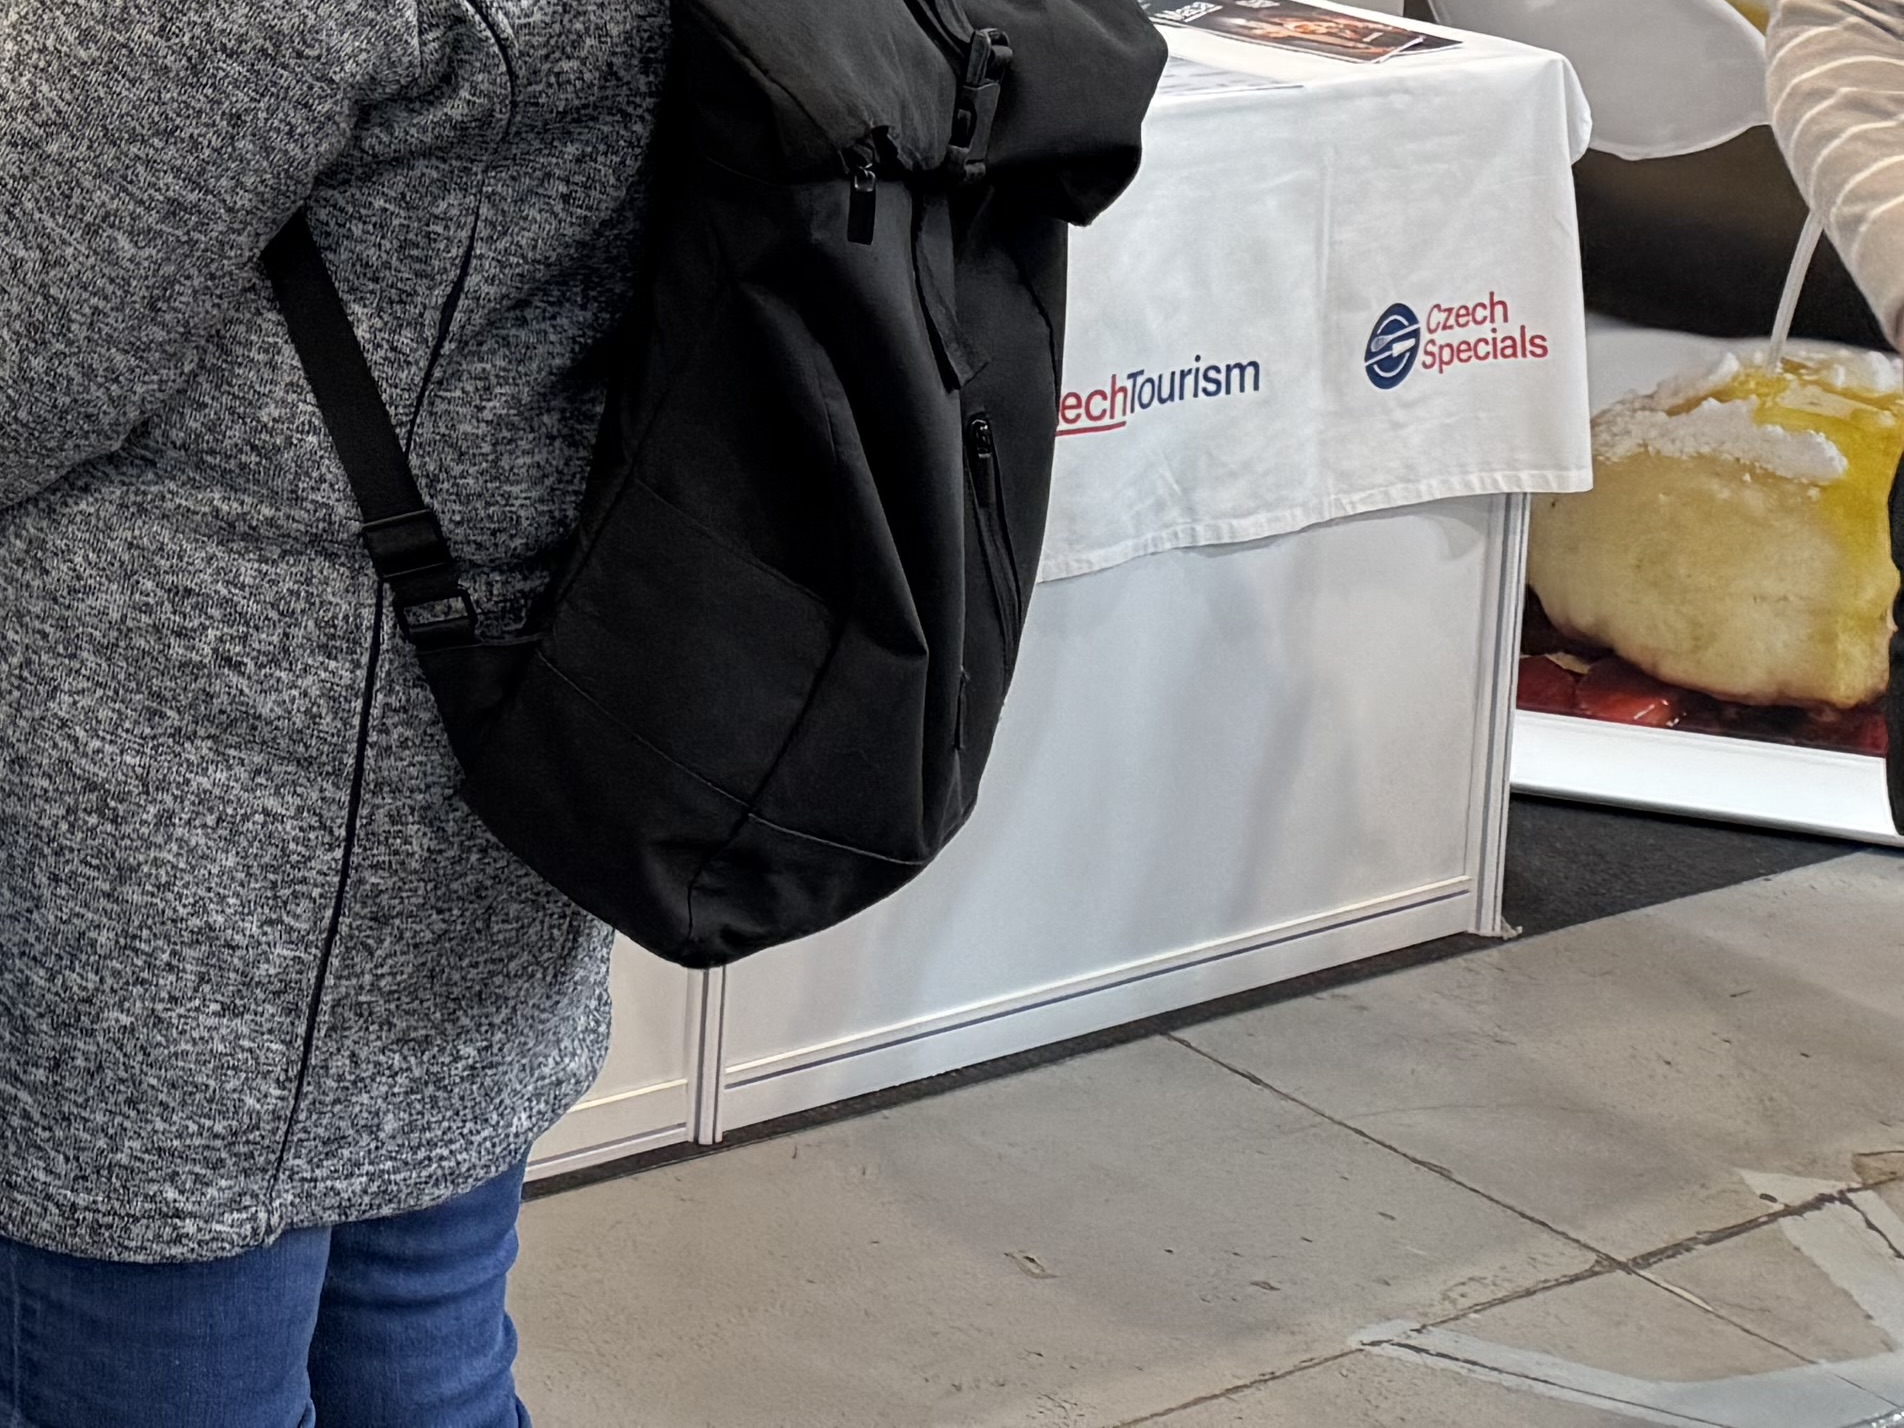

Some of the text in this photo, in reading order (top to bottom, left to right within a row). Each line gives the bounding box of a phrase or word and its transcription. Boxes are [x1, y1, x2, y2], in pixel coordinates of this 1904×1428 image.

[1426, 291, 1509, 334] Czech
[1422, 324, 1549, 374] Specials
[1059, 354, 1261, 425] echTourism
